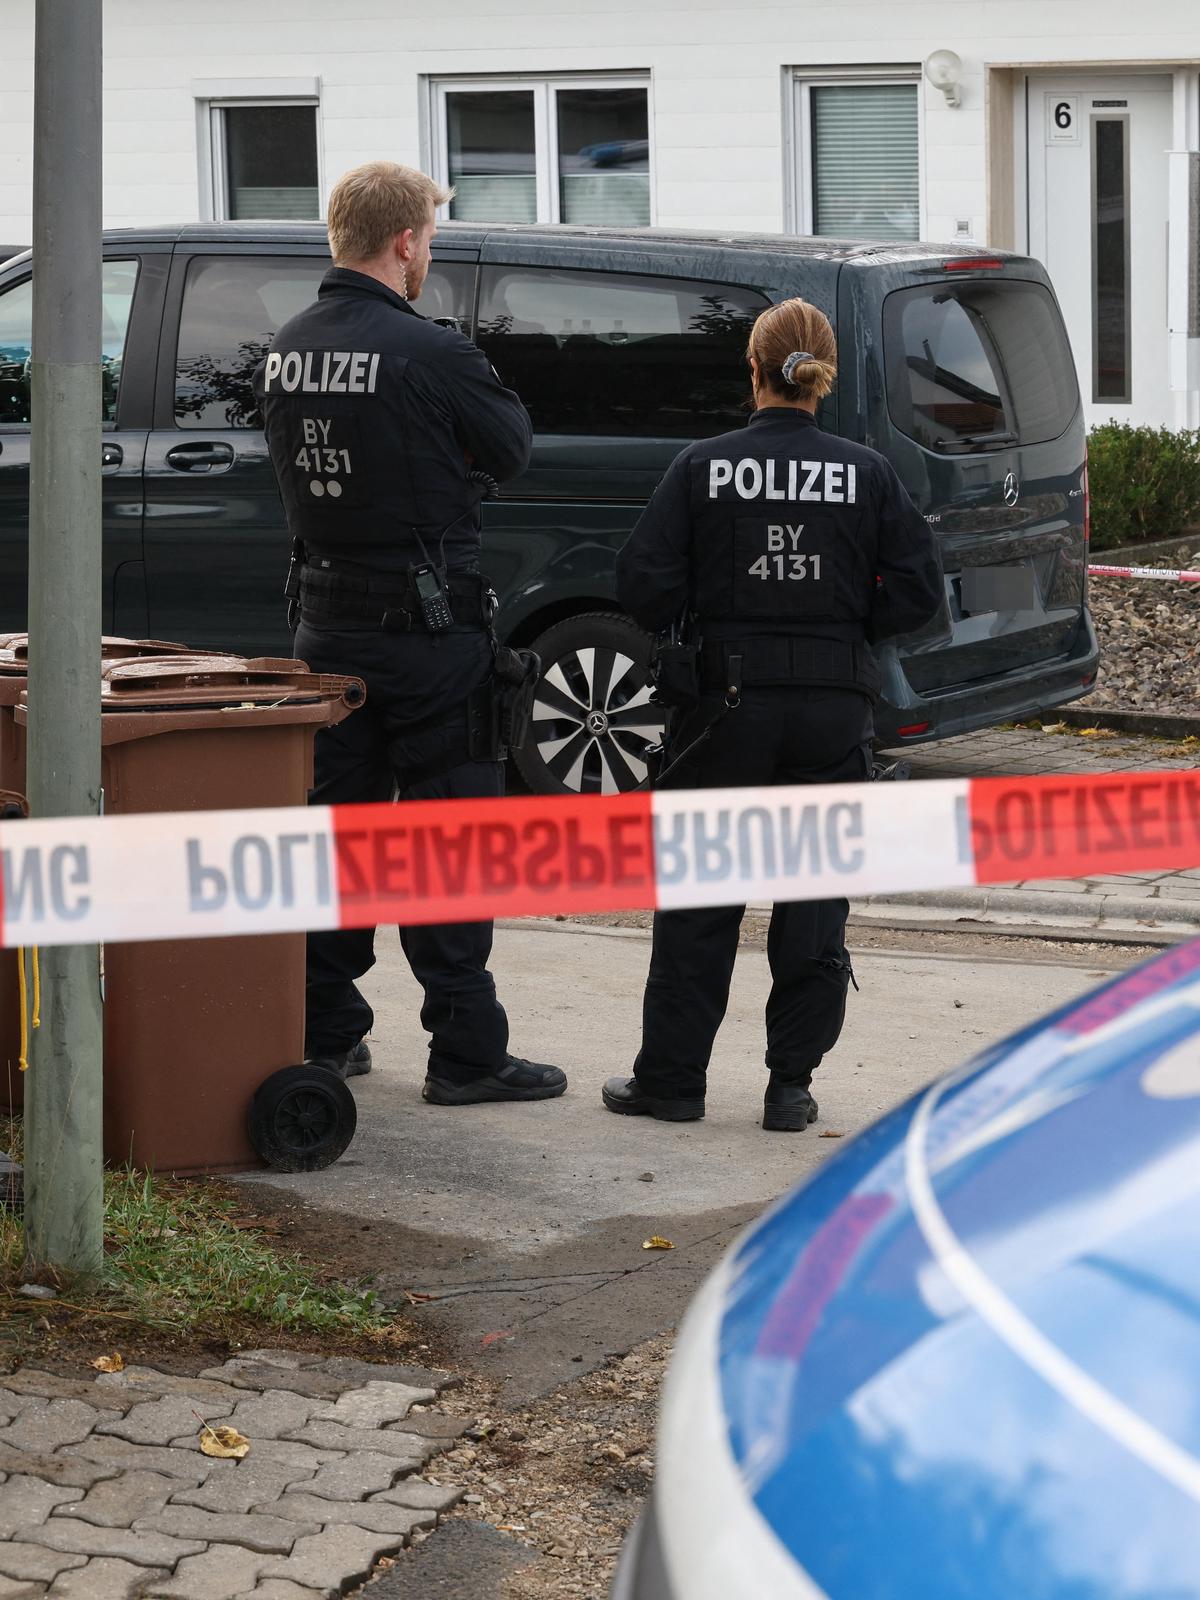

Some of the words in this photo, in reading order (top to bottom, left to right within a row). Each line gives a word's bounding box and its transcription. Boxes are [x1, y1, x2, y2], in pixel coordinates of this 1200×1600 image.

[1055, 102, 1071, 129] 6
[264, 351, 380, 393] POLIZEI
[303, 418, 332, 445] BY
[295, 447, 352, 474] 4131
[709, 458, 856, 504] POLIZEI
[767, 524, 805, 551] BY
[748, 554, 821, 581] 4131
